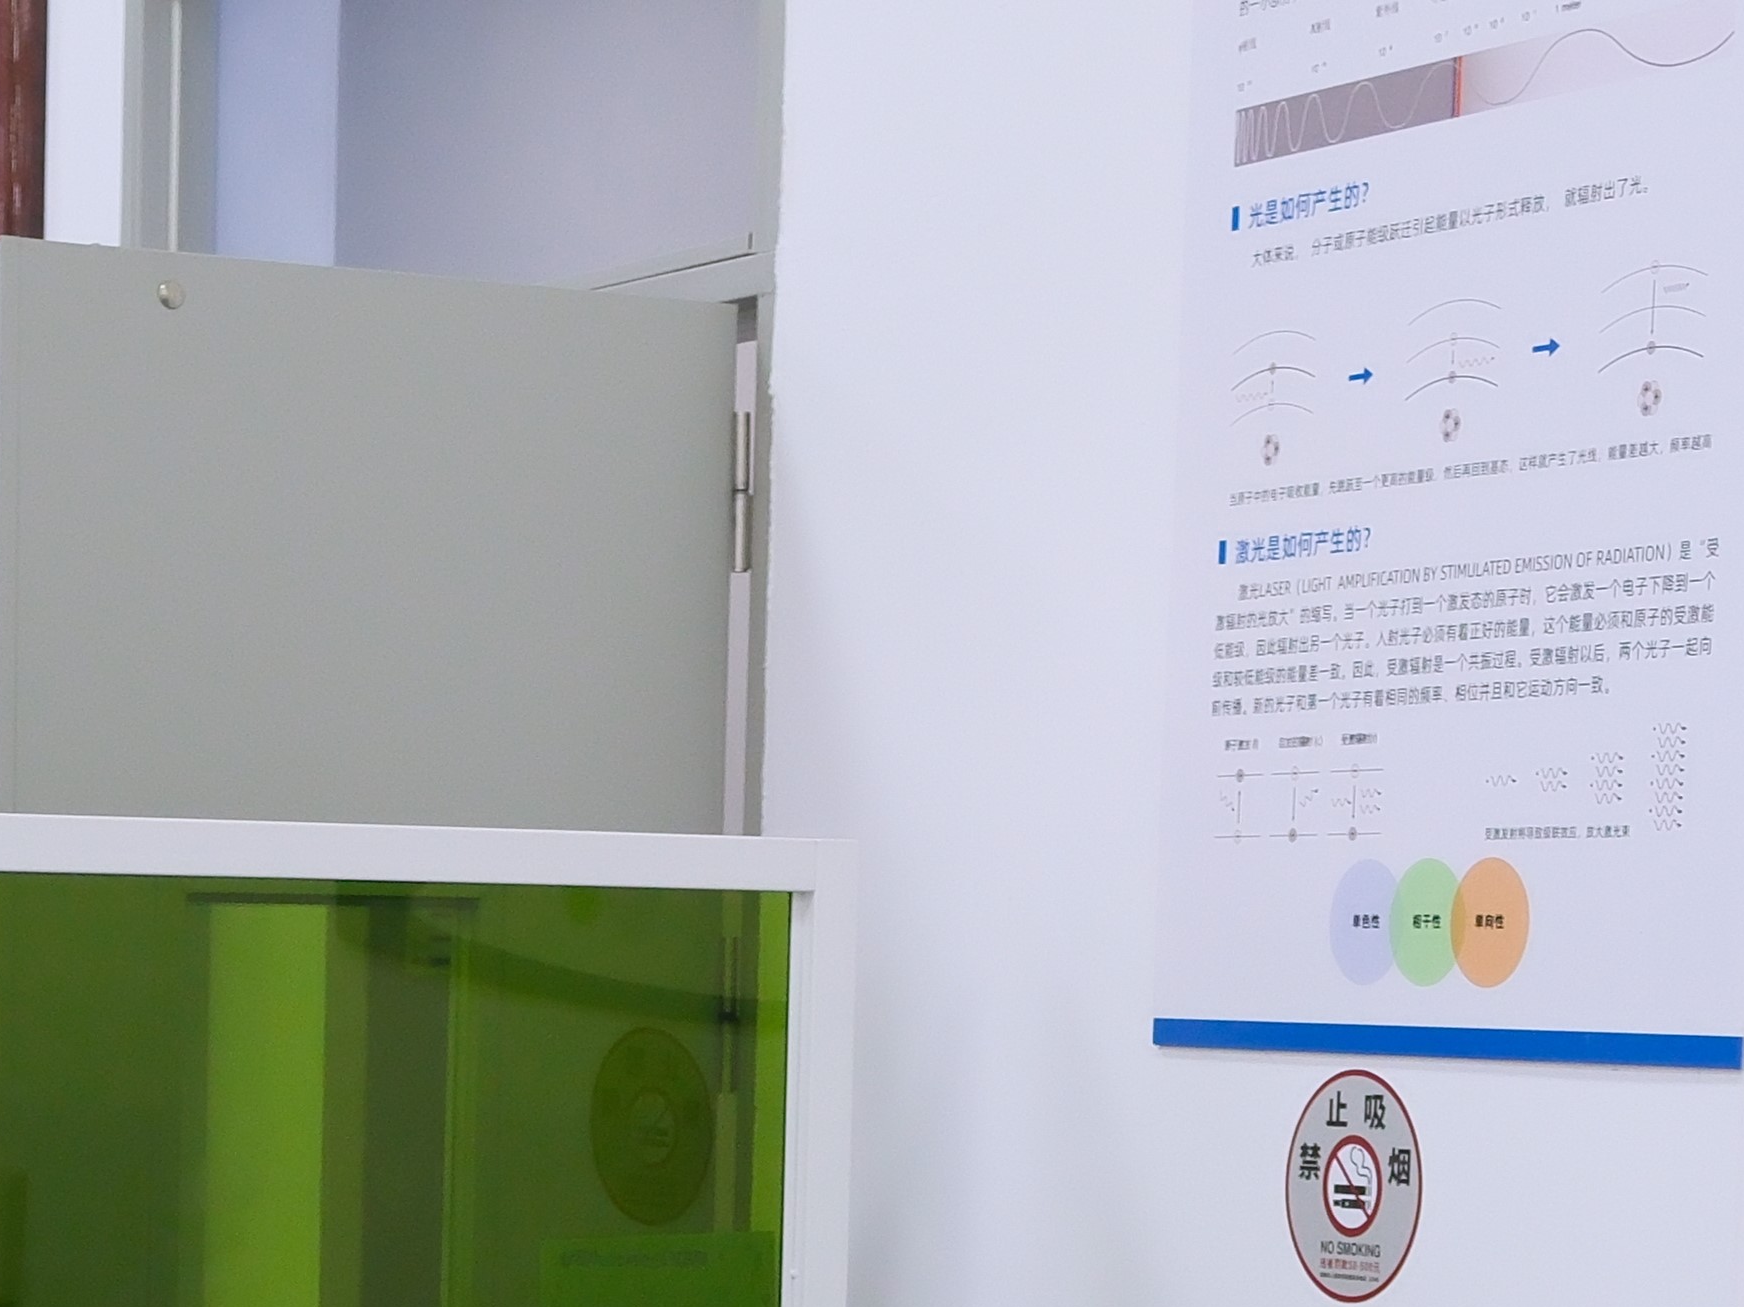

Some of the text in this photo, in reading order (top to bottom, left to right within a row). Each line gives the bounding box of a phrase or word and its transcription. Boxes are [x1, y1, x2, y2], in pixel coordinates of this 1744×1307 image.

[1247, 182, 1370, 230] 光是如何产生的？
[1235, 526, 1371, 565] 激光是如何产生的？
[1338, 567, 1421, 590] AMPLIFICATION
[1423, 565, 1439, 584] BY
[1440, 559, 1511, 581] STIMULATED
[1515, 553, 1572, 574] EMISSION
[1576, 550, 1593, 568] OF
[1352, 914, 1381, 929] 单色性
[1412, 914, 1442, 929] 相干性
[1320, 1240, 1381, 1259] NO SMOKING
